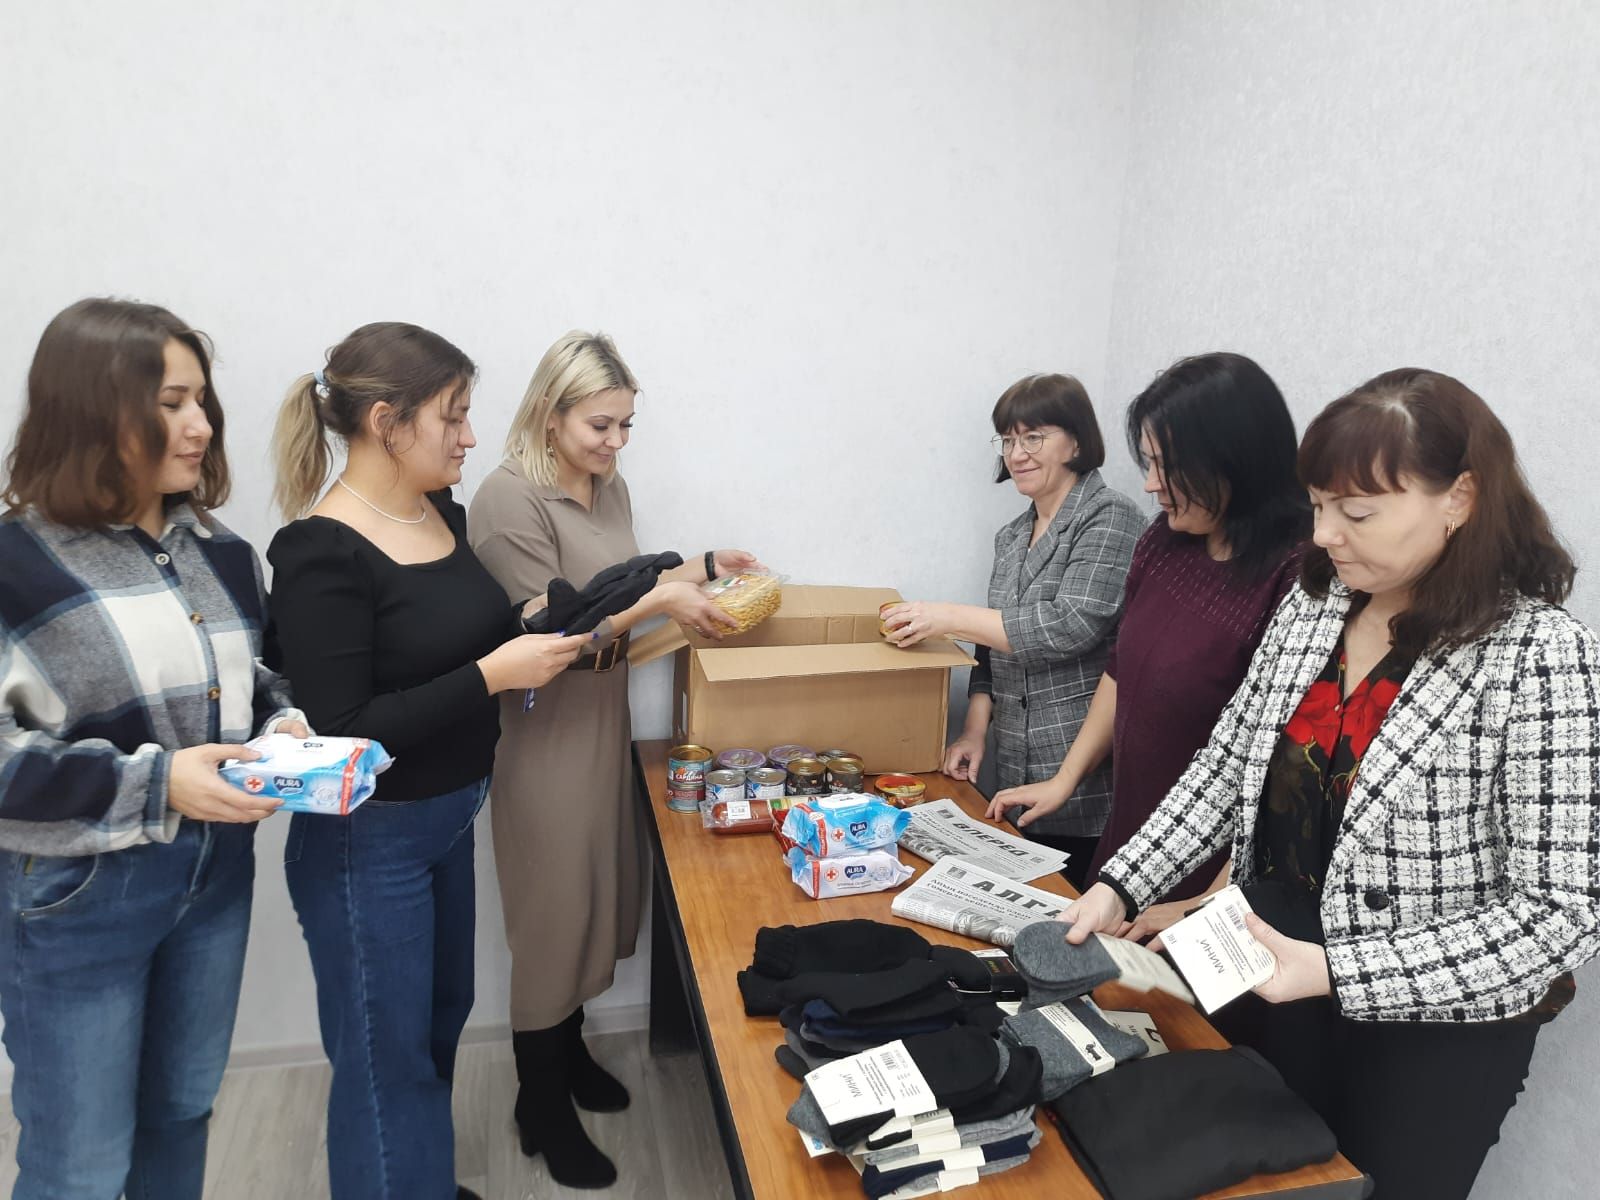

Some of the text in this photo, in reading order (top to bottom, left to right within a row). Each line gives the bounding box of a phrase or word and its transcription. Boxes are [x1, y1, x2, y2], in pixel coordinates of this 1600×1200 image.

[953, 822, 1030, 857] ВПЕРЕД
[846, 866, 864, 875] AURA
[1199, 939, 1225, 974] МИНИ
[842, 1073, 863, 1098] МИНИ
